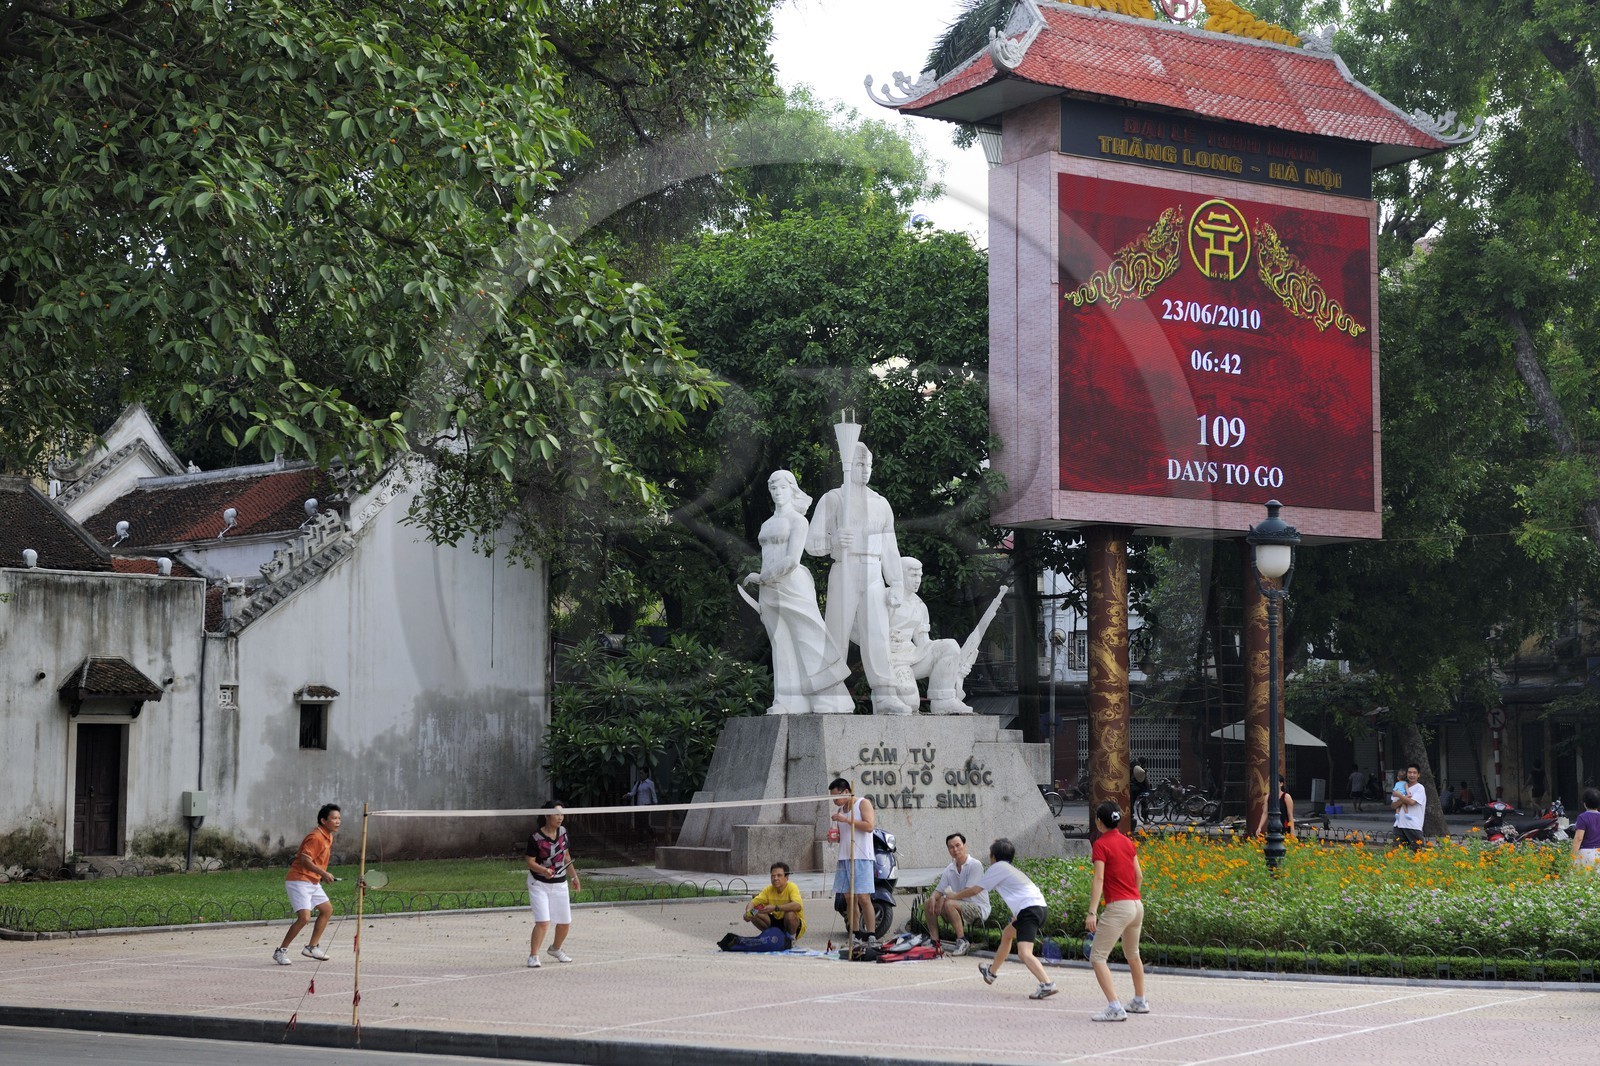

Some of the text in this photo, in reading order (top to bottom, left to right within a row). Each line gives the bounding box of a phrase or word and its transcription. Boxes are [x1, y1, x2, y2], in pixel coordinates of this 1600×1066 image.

[1098, 136, 1177, 163] THĂNG
[1183, 148, 1243, 173] LONG
[1269, 161, 1299, 182] HÀ
[1305, 168, 1342, 191] NỘI
[1162, 299, 1261, 330] 23/06/2010
[1191, 350, 1242, 375] 06:42
[1197, 414, 1246, 448] 109
[1167, 459, 1284, 488] DAYS TO GO
[907, 764, 935, 786] TỔ
[944, 764, 994, 787] QUỐC
